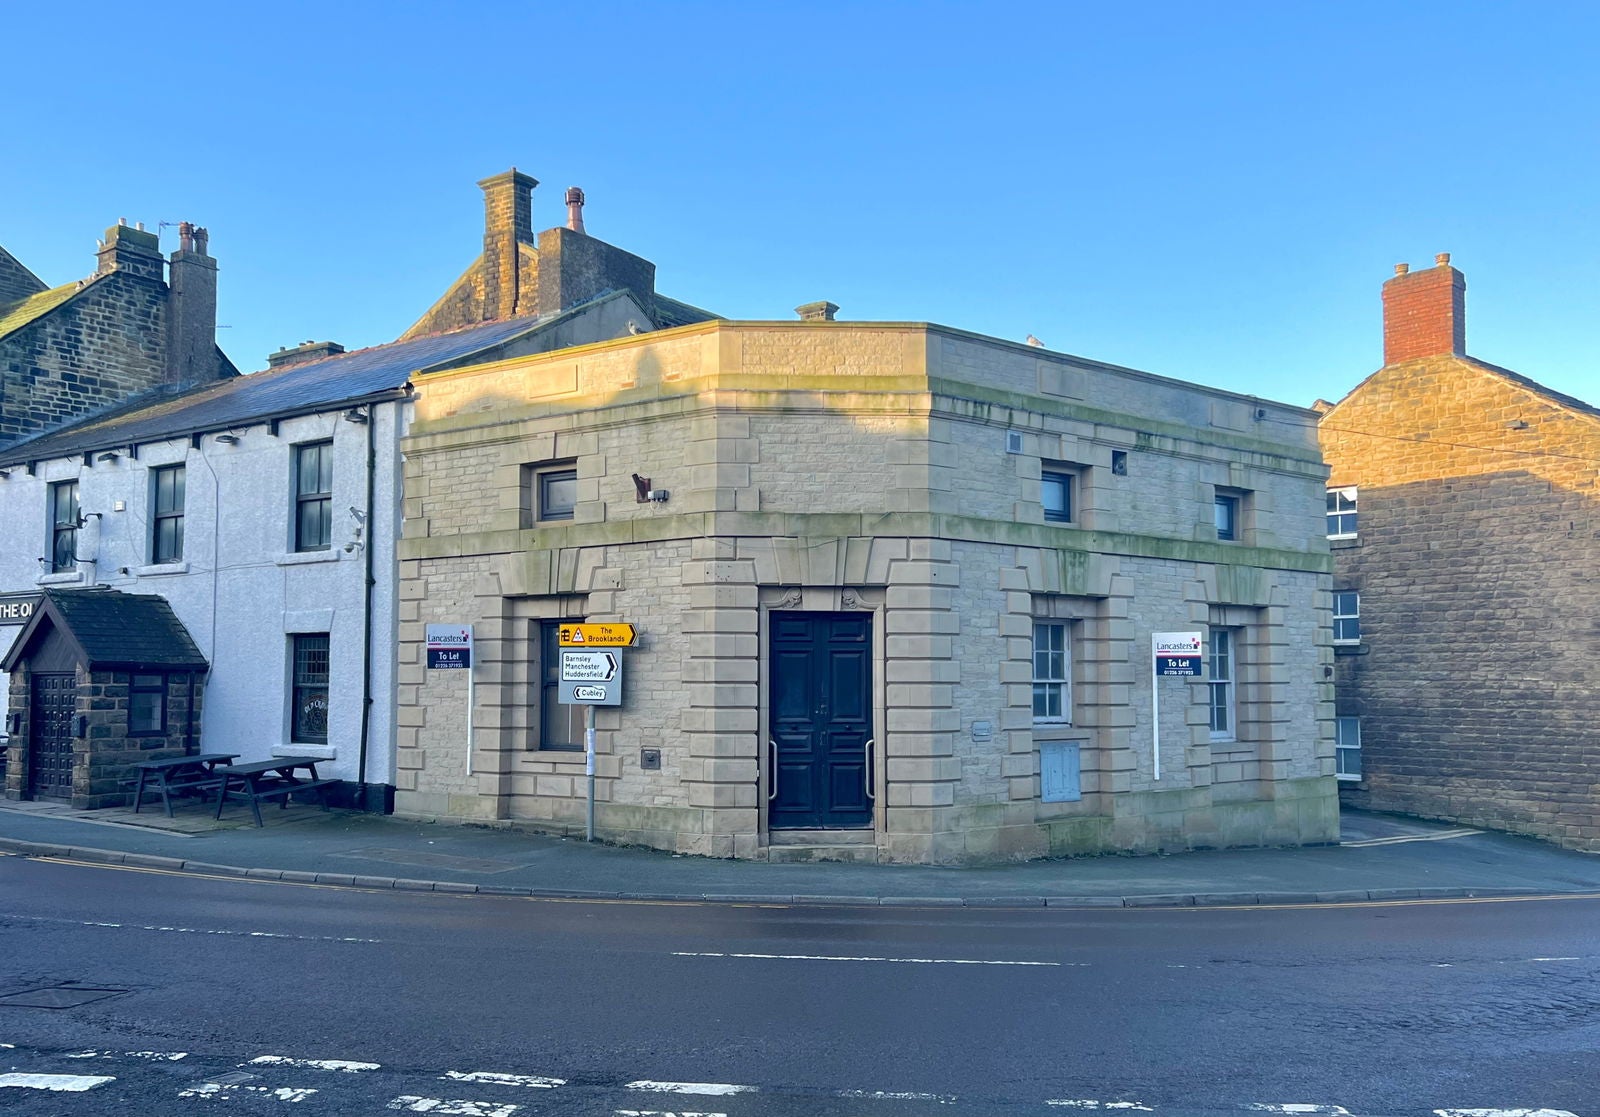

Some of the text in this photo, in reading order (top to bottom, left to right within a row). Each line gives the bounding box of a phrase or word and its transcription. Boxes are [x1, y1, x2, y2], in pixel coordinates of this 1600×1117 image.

[600, 627, 612, 635] The
[428, 634, 463, 642] Lancasters
[1156, 642, 1192, 650] Lancasters
[439, 652, 459, 660] To Let
[1168, 659, 1190, 667] To Let
[581, 690, 603, 698] Cubley
